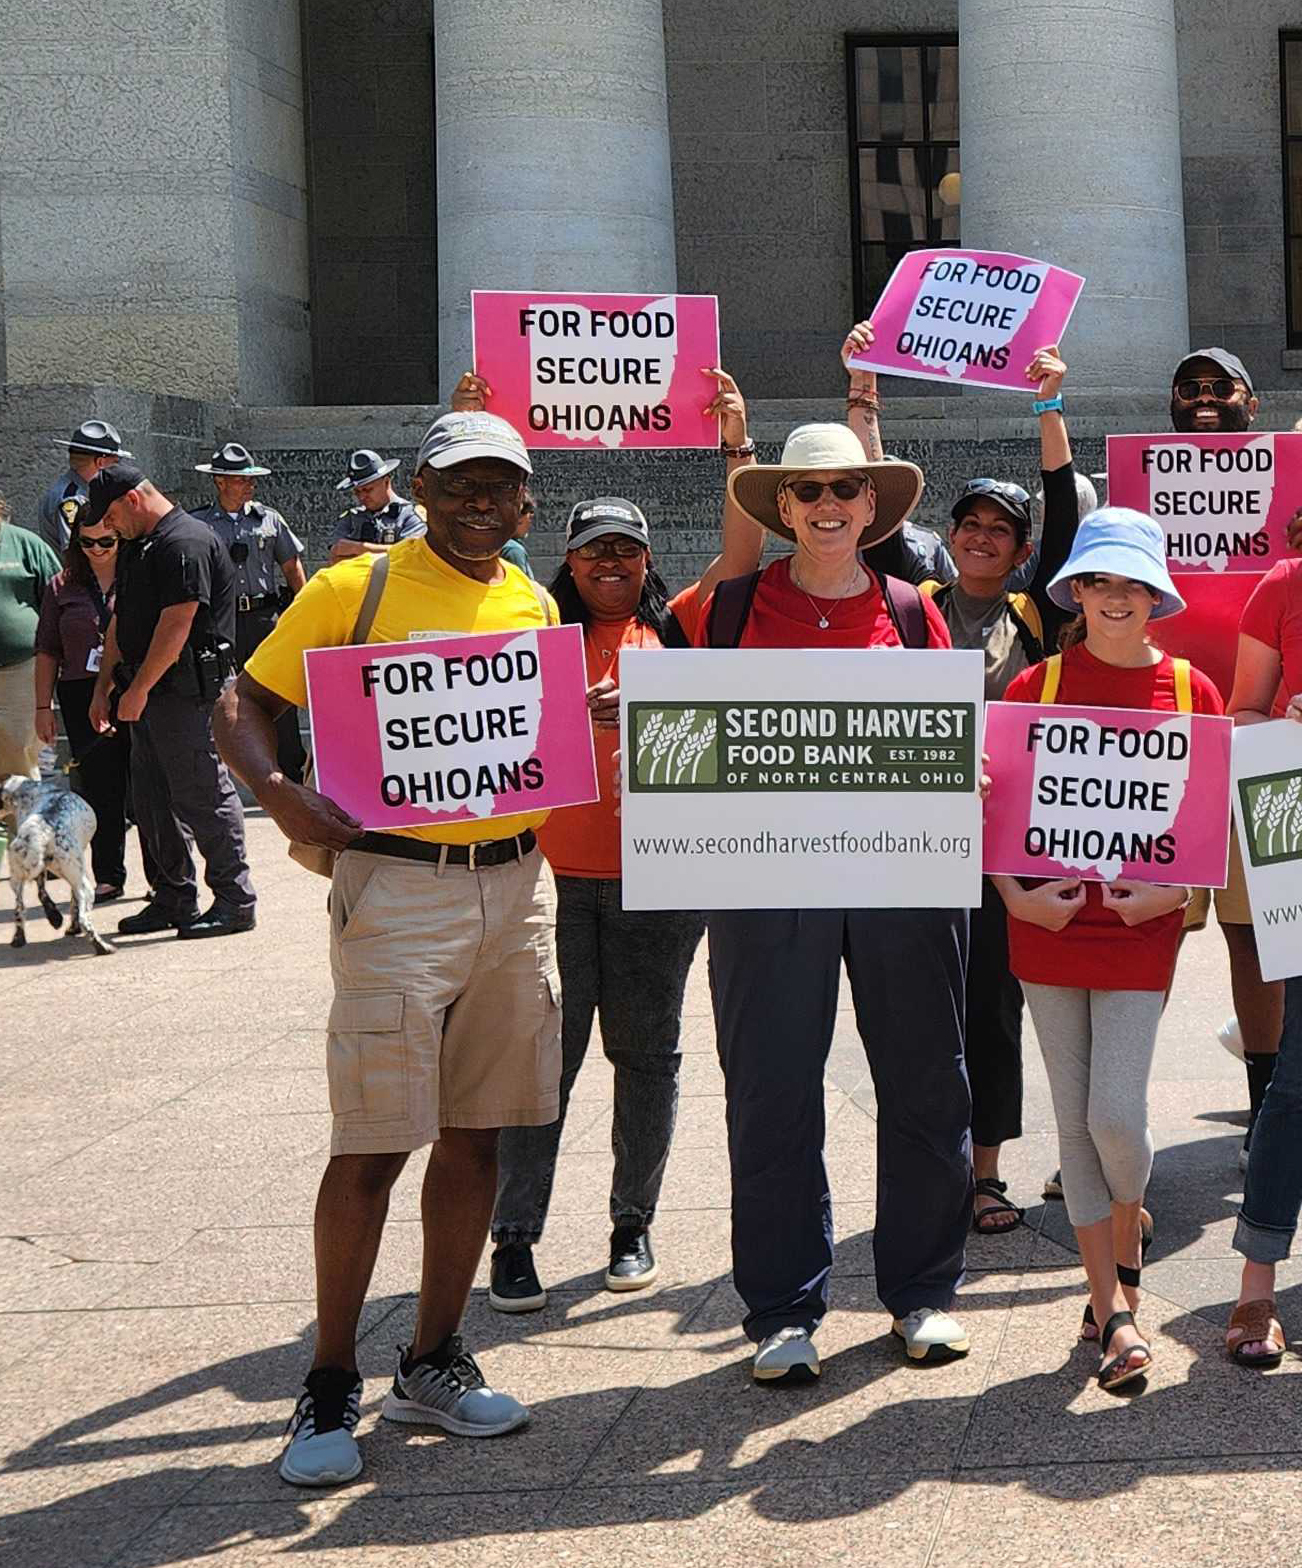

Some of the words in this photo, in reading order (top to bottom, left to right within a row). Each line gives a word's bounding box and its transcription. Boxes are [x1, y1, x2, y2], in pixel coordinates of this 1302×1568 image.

[919, 261, 968, 283] FOR
[970, 264, 1041, 295] FOOD
[519, 309, 581, 338] FOR
[590, 310, 675, 339] FOOD
[916, 295, 1017, 331] SECURE
[896, 331, 1011, 371] OHIOANS
[536, 356, 662, 385] SECURE
[528, 403, 672, 432] OHIOANS
[1141, 449, 1192, 475] FOR
[1199, 447, 1273, 473] FOOD
[1154, 490, 1261, 516] SECURE
[1165, 530, 1270, 558] HIOANS
[360, 661, 435, 698] FOR
[443, 650, 538, 690] FOOD
[385, 704, 529, 752] SECURE
[725, 708, 837, 738] SECOND
[847, 709, 968, 738] HARVEST
[727, 745, 796, 765] FOOD
[803, 745, 875, 765] BANK
[889, 750, 918, 761] EST.
[923, 749, 957, 761] 1982
[1027, 722, 1091, 755] FOR
[1098, 726, 1188, 761] FOOD
[380, 757, 544, 808] OHIOANS
[727, 772, 750, 785] OF
[758, 772, 820, 784] NORTH
[829, 771, 911, 784] CENTRAL
[919, 772, 966, 785] OHIO
[1037, 774, 1170, 813] SECURE
[632, 829, 972, 859] www.secondharvestfoodbank.org
[1024, 826, 1176, 865] OHIOANS
